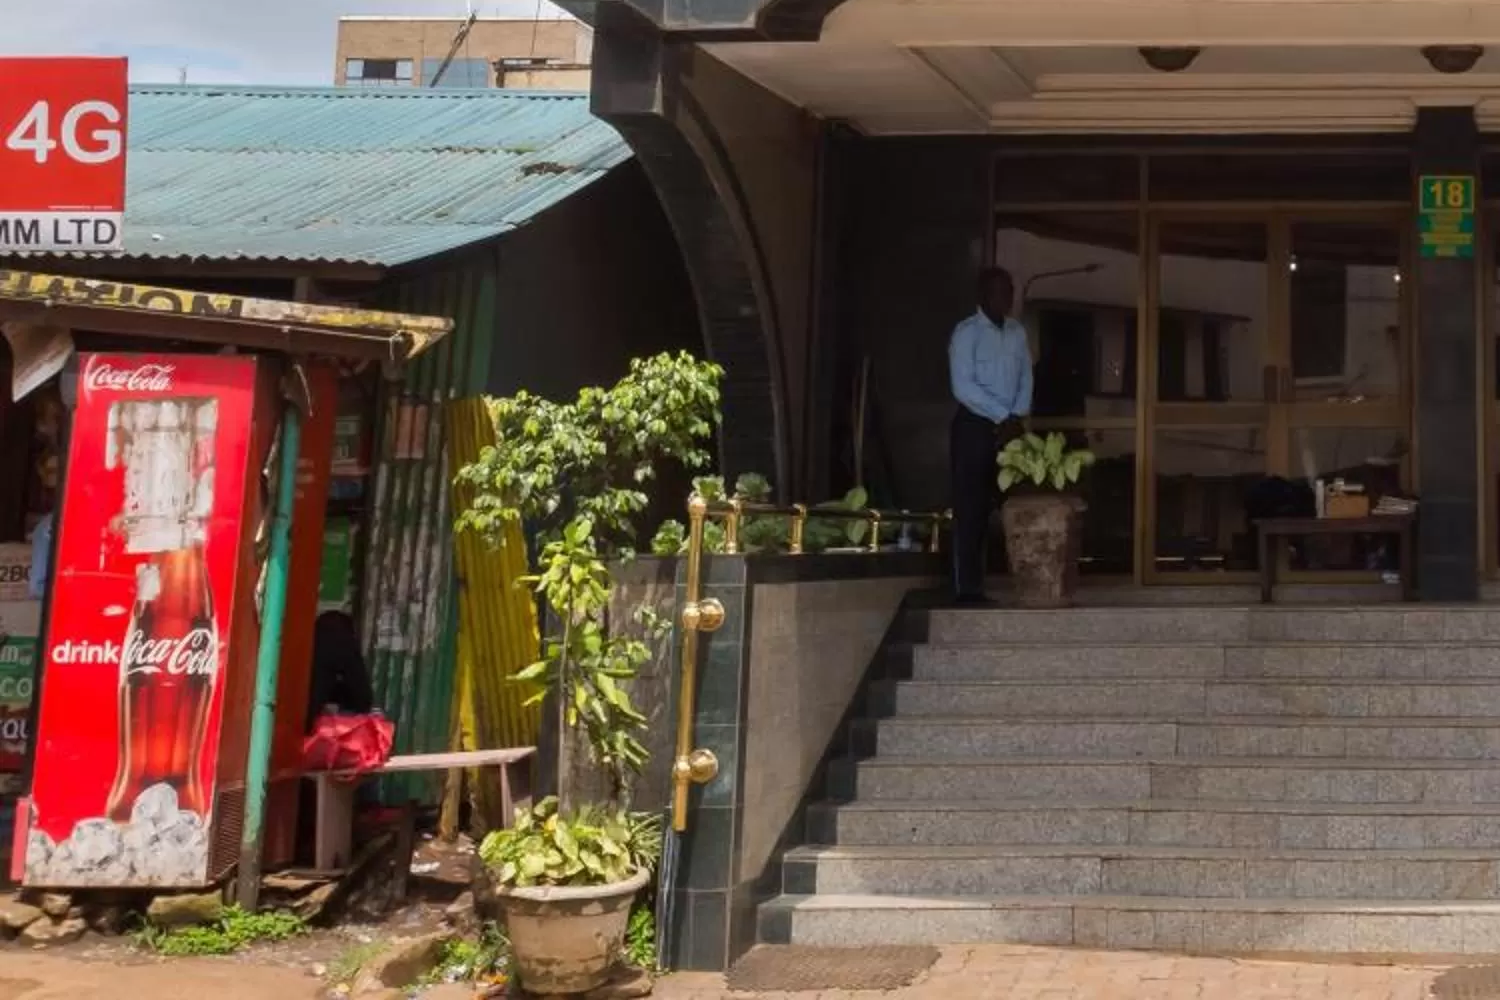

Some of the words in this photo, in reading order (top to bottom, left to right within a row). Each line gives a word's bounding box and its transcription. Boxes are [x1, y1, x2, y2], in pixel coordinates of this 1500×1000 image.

[6, 100, 121, 164] 4G
[1430, 181, 1464, 207] 18
[53, 218, 117, 245] LTD
[52, 639, 121, 665] drink
